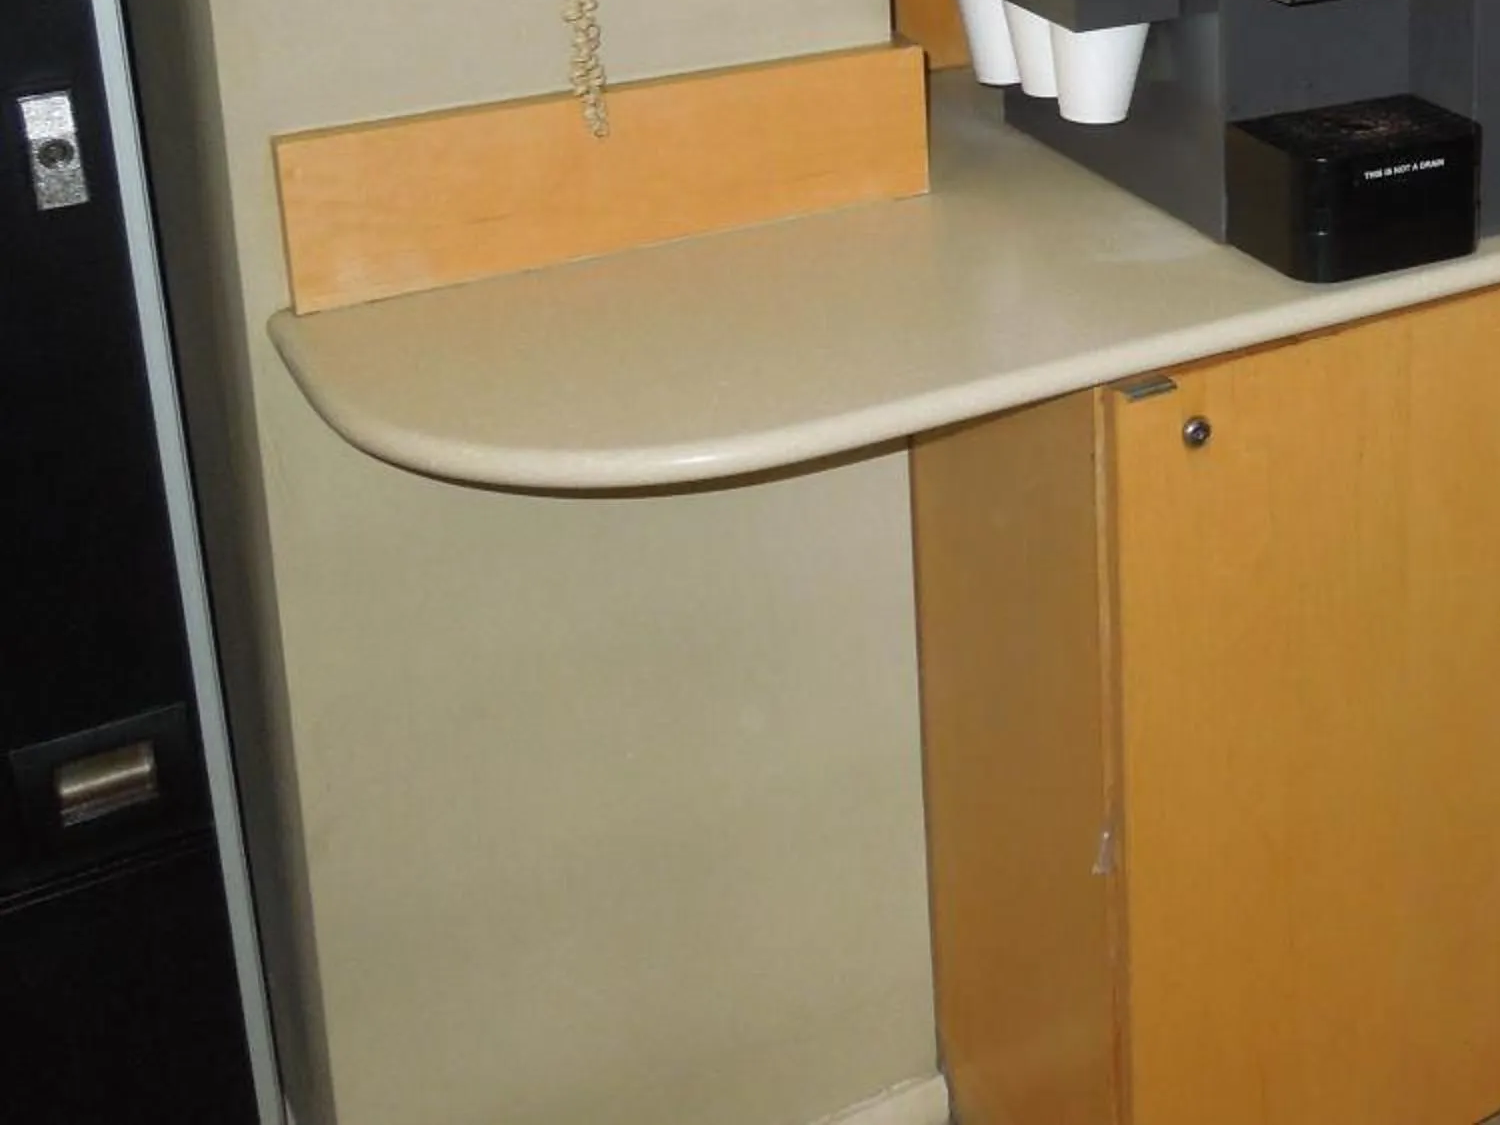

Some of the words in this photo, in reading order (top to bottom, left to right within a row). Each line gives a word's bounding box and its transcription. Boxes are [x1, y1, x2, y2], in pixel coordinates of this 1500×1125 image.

[1364, 168, 1383, 180] THIS
[1393, 163, 1411, 176] NOT
[1411, 162, 1419, 172] A
[1419, 158, 1445, 170] DRAIN
